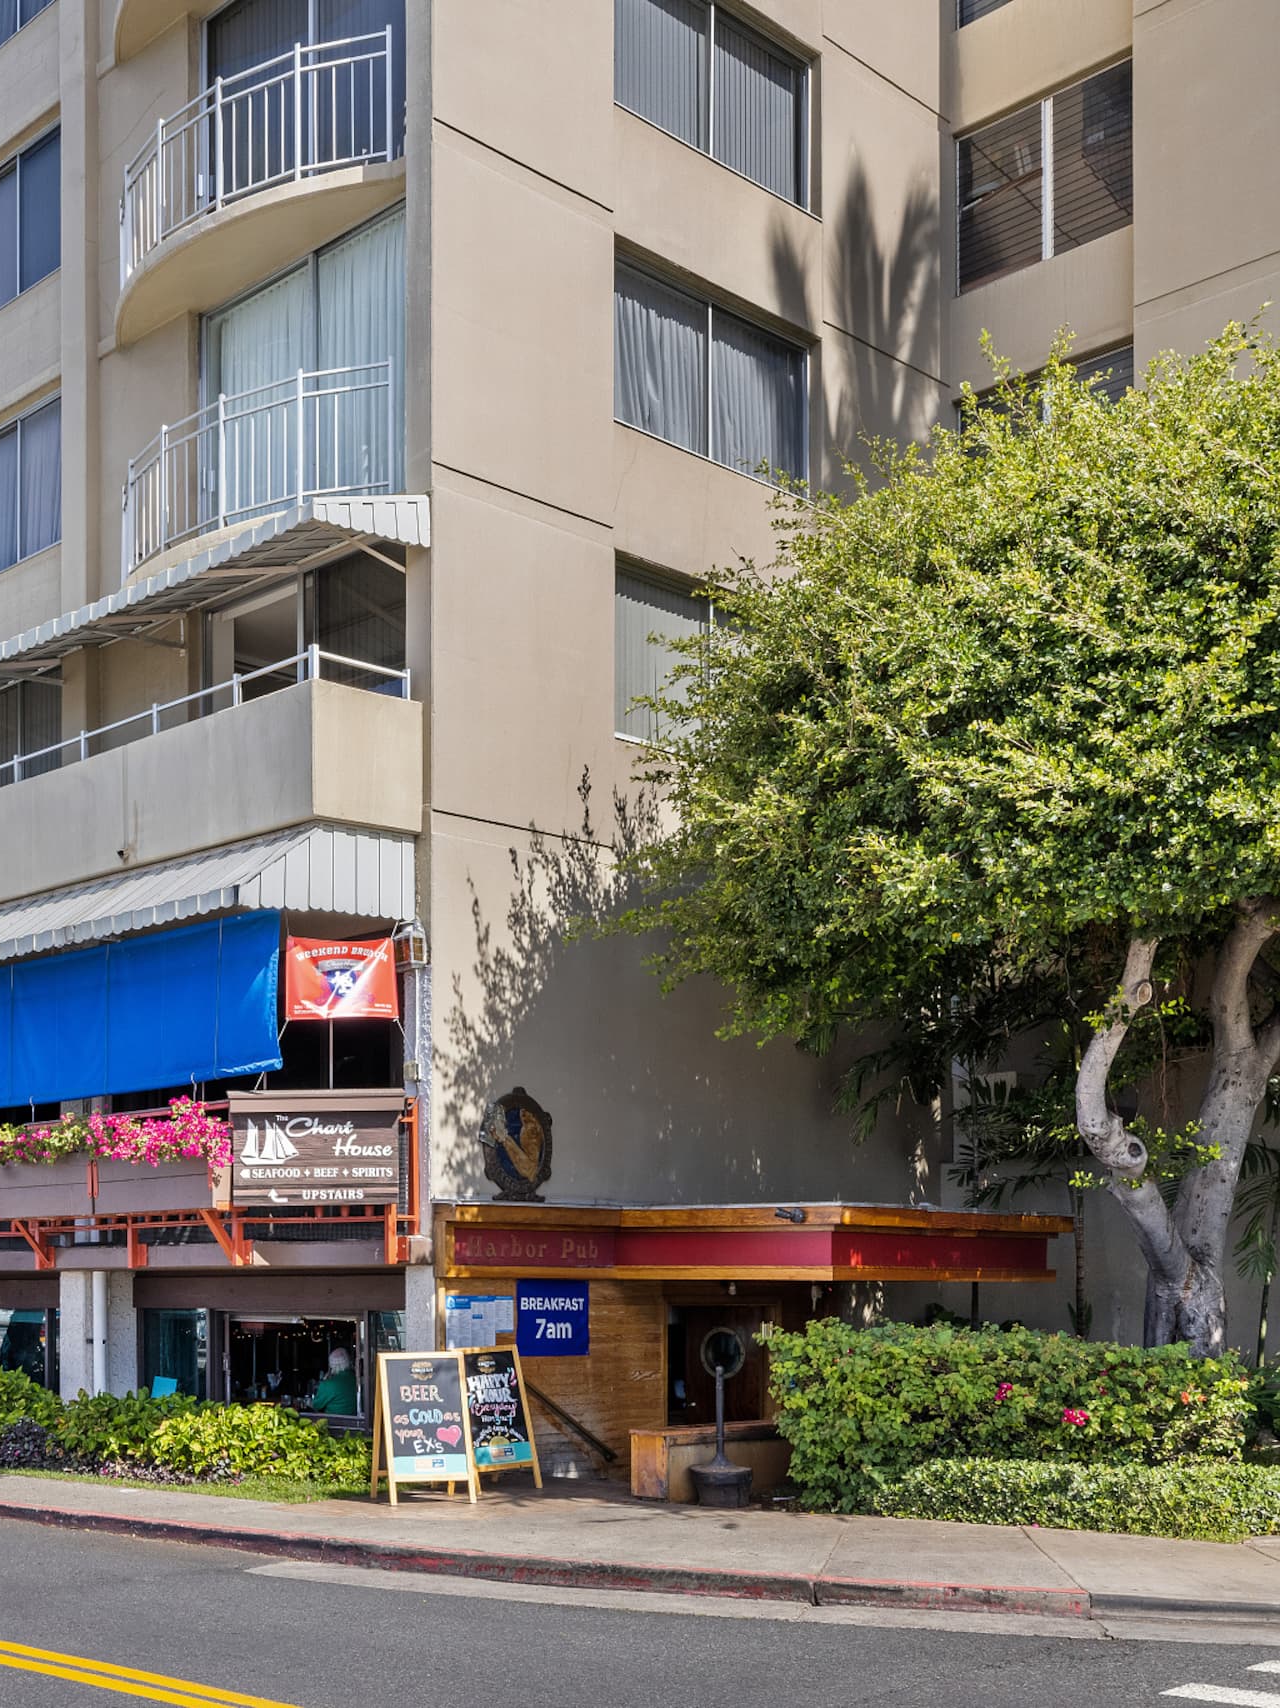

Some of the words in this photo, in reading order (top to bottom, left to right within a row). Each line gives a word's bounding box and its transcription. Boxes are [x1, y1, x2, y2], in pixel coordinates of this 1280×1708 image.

[285, 1117, 354, 1137] Chart
[332, 1134, 393, 1157] House
[252, 1168, 300, 1178] SEAFOOD
[314, 1168, 339, 1178] BEEF
[352, 1167, 393, 1178] SPIRITS
[302, 1189, 364, 1200] UPSTAIRS
[466, 1235, 547, 1258] Harbor
[560, 1238, 598, 1259] Pub
[520, 1297, 584, 1311] BREAKFAST
[535, 1318, 572, 1339] 7am
[467, 1373, 510, 1391] HAPPY
[400, 1385, 444, 1402] BEER
[476, 1387, 518, 1403] HOUR
[409, 1409, 444, 1425] COLD
